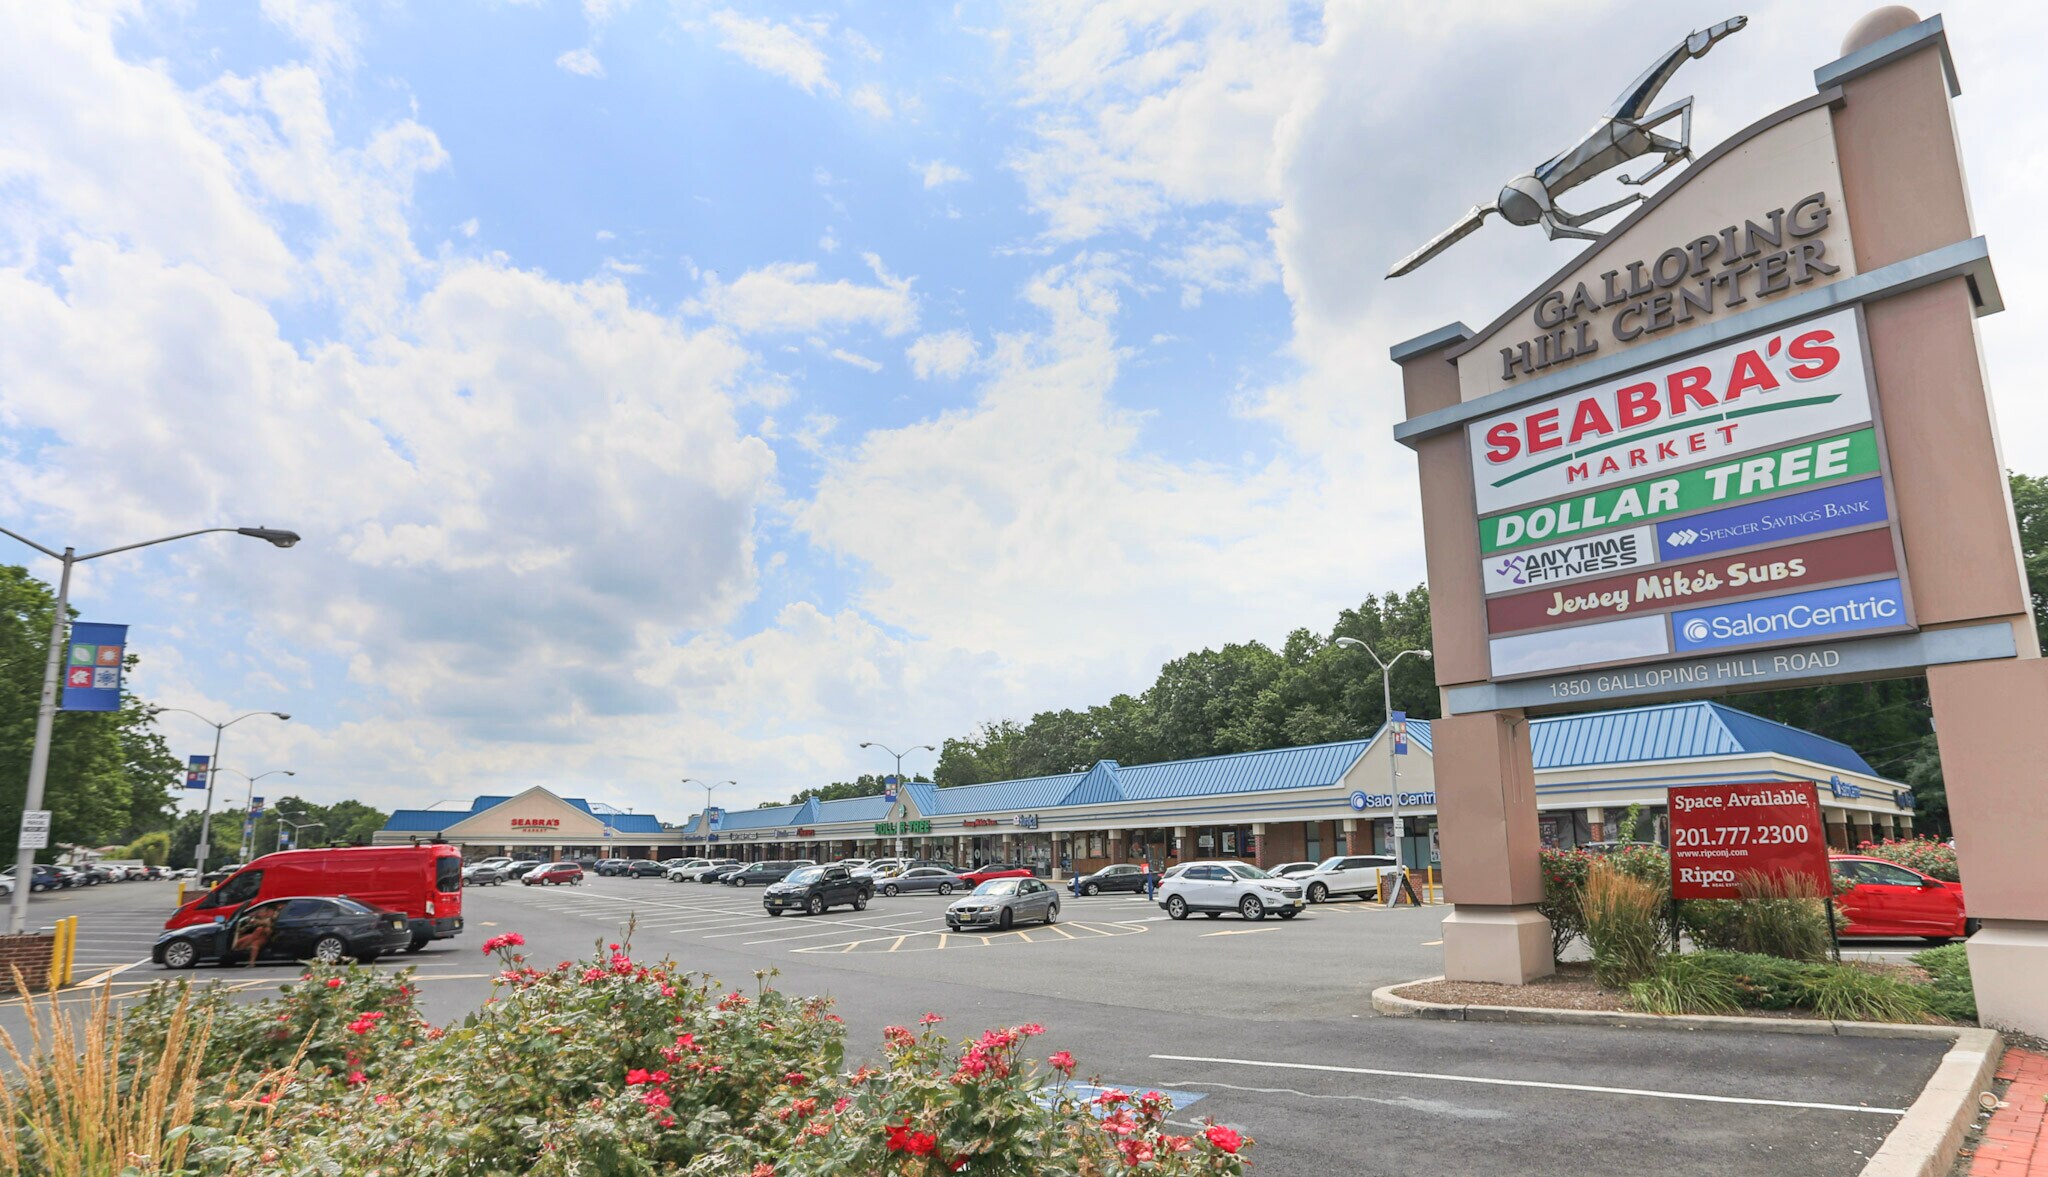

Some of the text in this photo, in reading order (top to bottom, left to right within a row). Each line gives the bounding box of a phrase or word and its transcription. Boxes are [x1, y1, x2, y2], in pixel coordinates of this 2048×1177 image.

[1533, 191, 1832, 330] GALLOPING
[1500, 239, 1841, 381] HILL CENTER
[1485, 329, 1841, 464] SEABRA'S
[1567, 423, 1739, 483] MARKET
[1495, 438, 1851, 547] DOLLAR TREE
[1525, 534, 1636, 571] ANYTIME
[1528, 551, 1638, 583] FITNESS
[1546, 591, 1630, 616] Jersey
[1635, 570, 1723, 603] Mike's
[1712, 597, 1897, 639] SalonCentric
[1550, 650, 1840, 697] 1350 GALLOPING HILL ROAD
[1366, 791, 1436, 808] SaloCentri
[1675, 790, 1808, 812] Space Available
[511, 818, 560, 826] SEABRA'S
[908, 820, 931, 833] TREE
[1675, 824, 1809, 847] 201.777.2300
[1677, 848, 1749, 858] www.ripconj.com
[1679, 866, 1735, 888] Ripco
